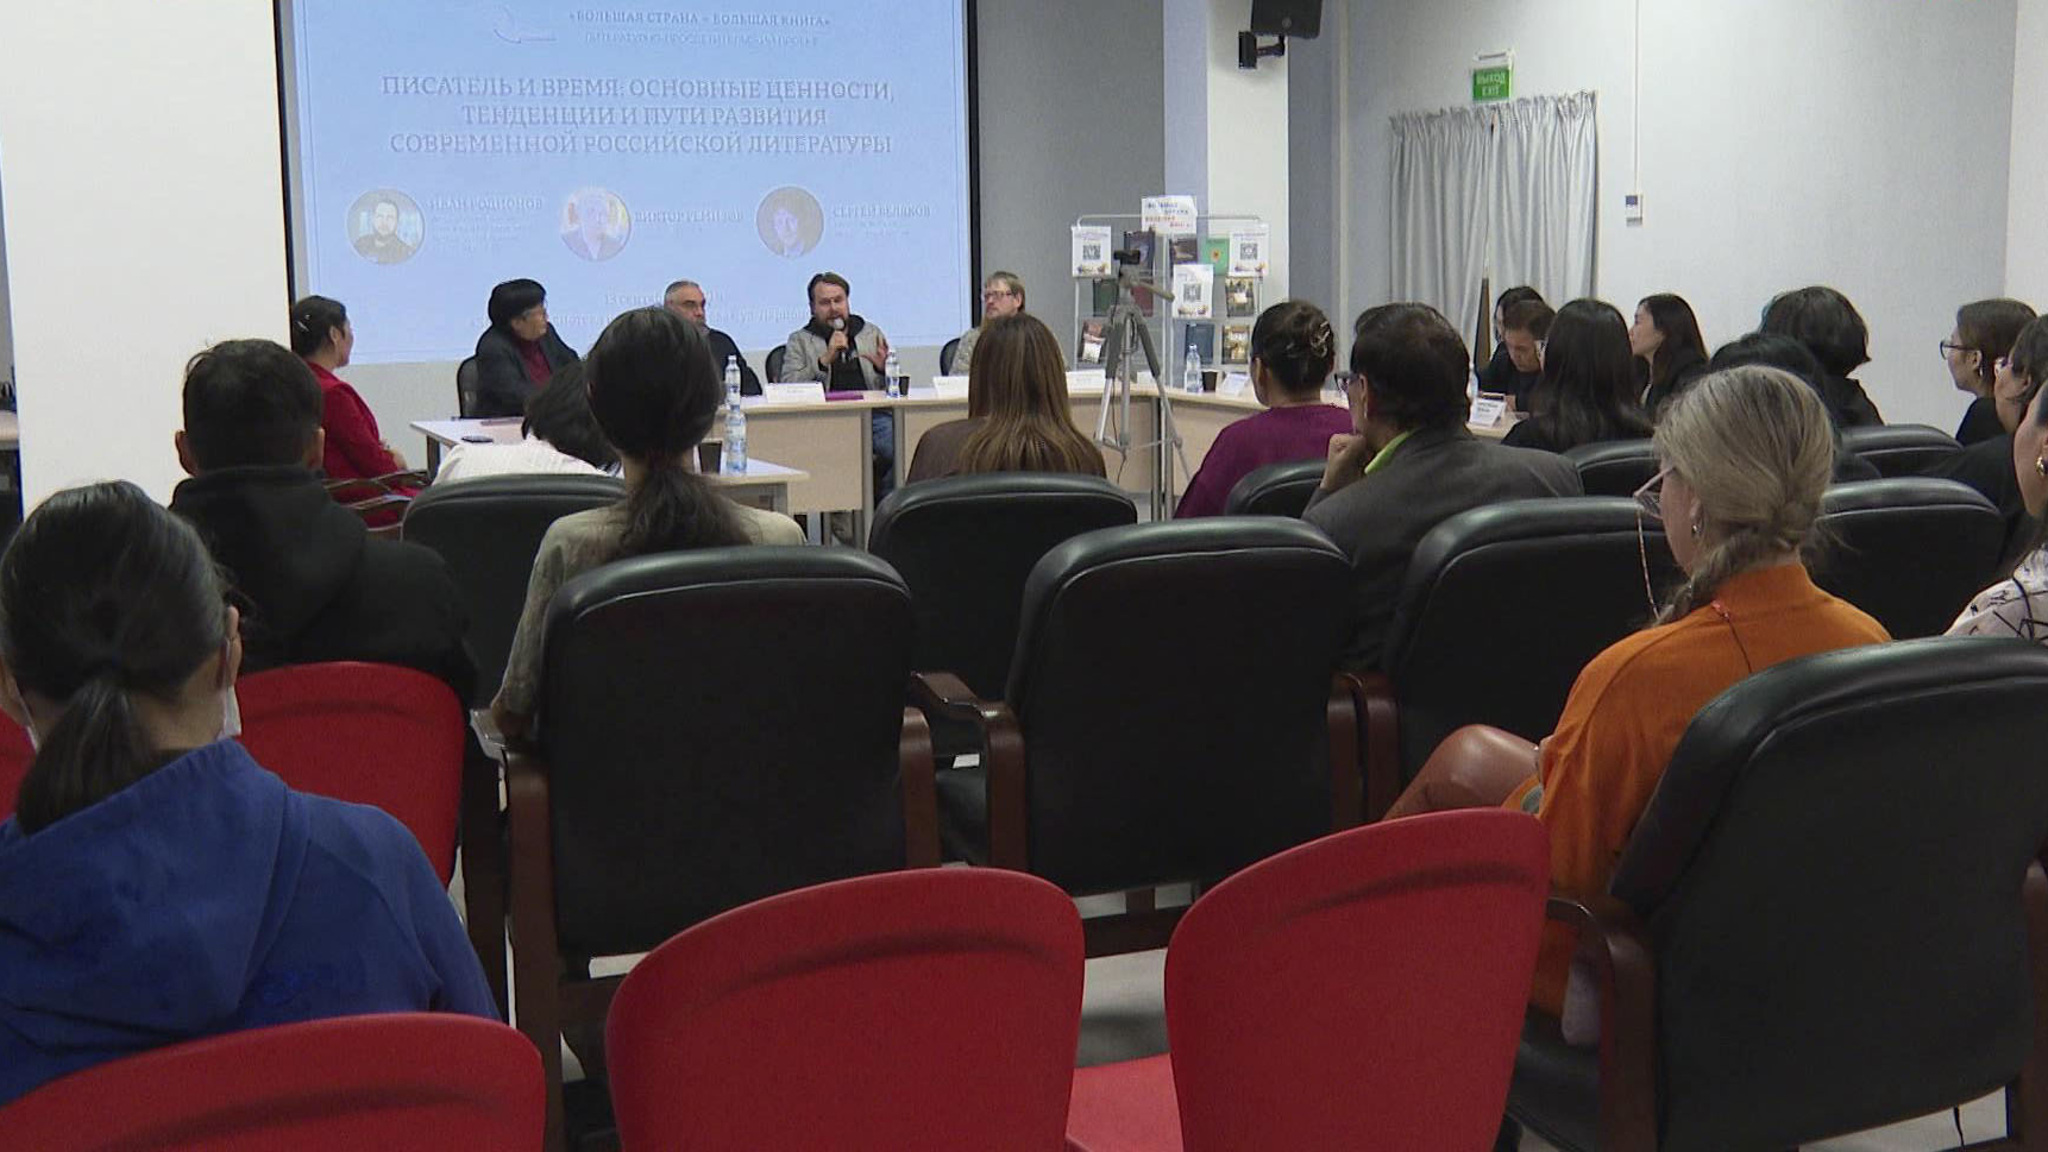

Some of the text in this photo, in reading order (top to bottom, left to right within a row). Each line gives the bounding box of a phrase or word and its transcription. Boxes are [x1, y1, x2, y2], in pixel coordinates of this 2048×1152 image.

[646, 11, 698, 25] СТРАНА
[712, 12, 778, 26] БОЛЬШАЯ
[1475, 71, 1506, 85] ВЫХОД
[381, 76, 895, 103] ПИСАТЕЛЬ И ВРЕМЯ: ОСНОВНЫЕ ЦЕННОСТИ,
[1482, 84, 1501, 97] EXIT
[461, 105, 827, 128] ТЕНДЕНЦИИ И ПУТИ РАЗВИТИЯ
[390, 130, 891, 154] СОВРЕМЕННОЙ РОССИЙСКОЙ ЛИТЕРАТУРЫ
